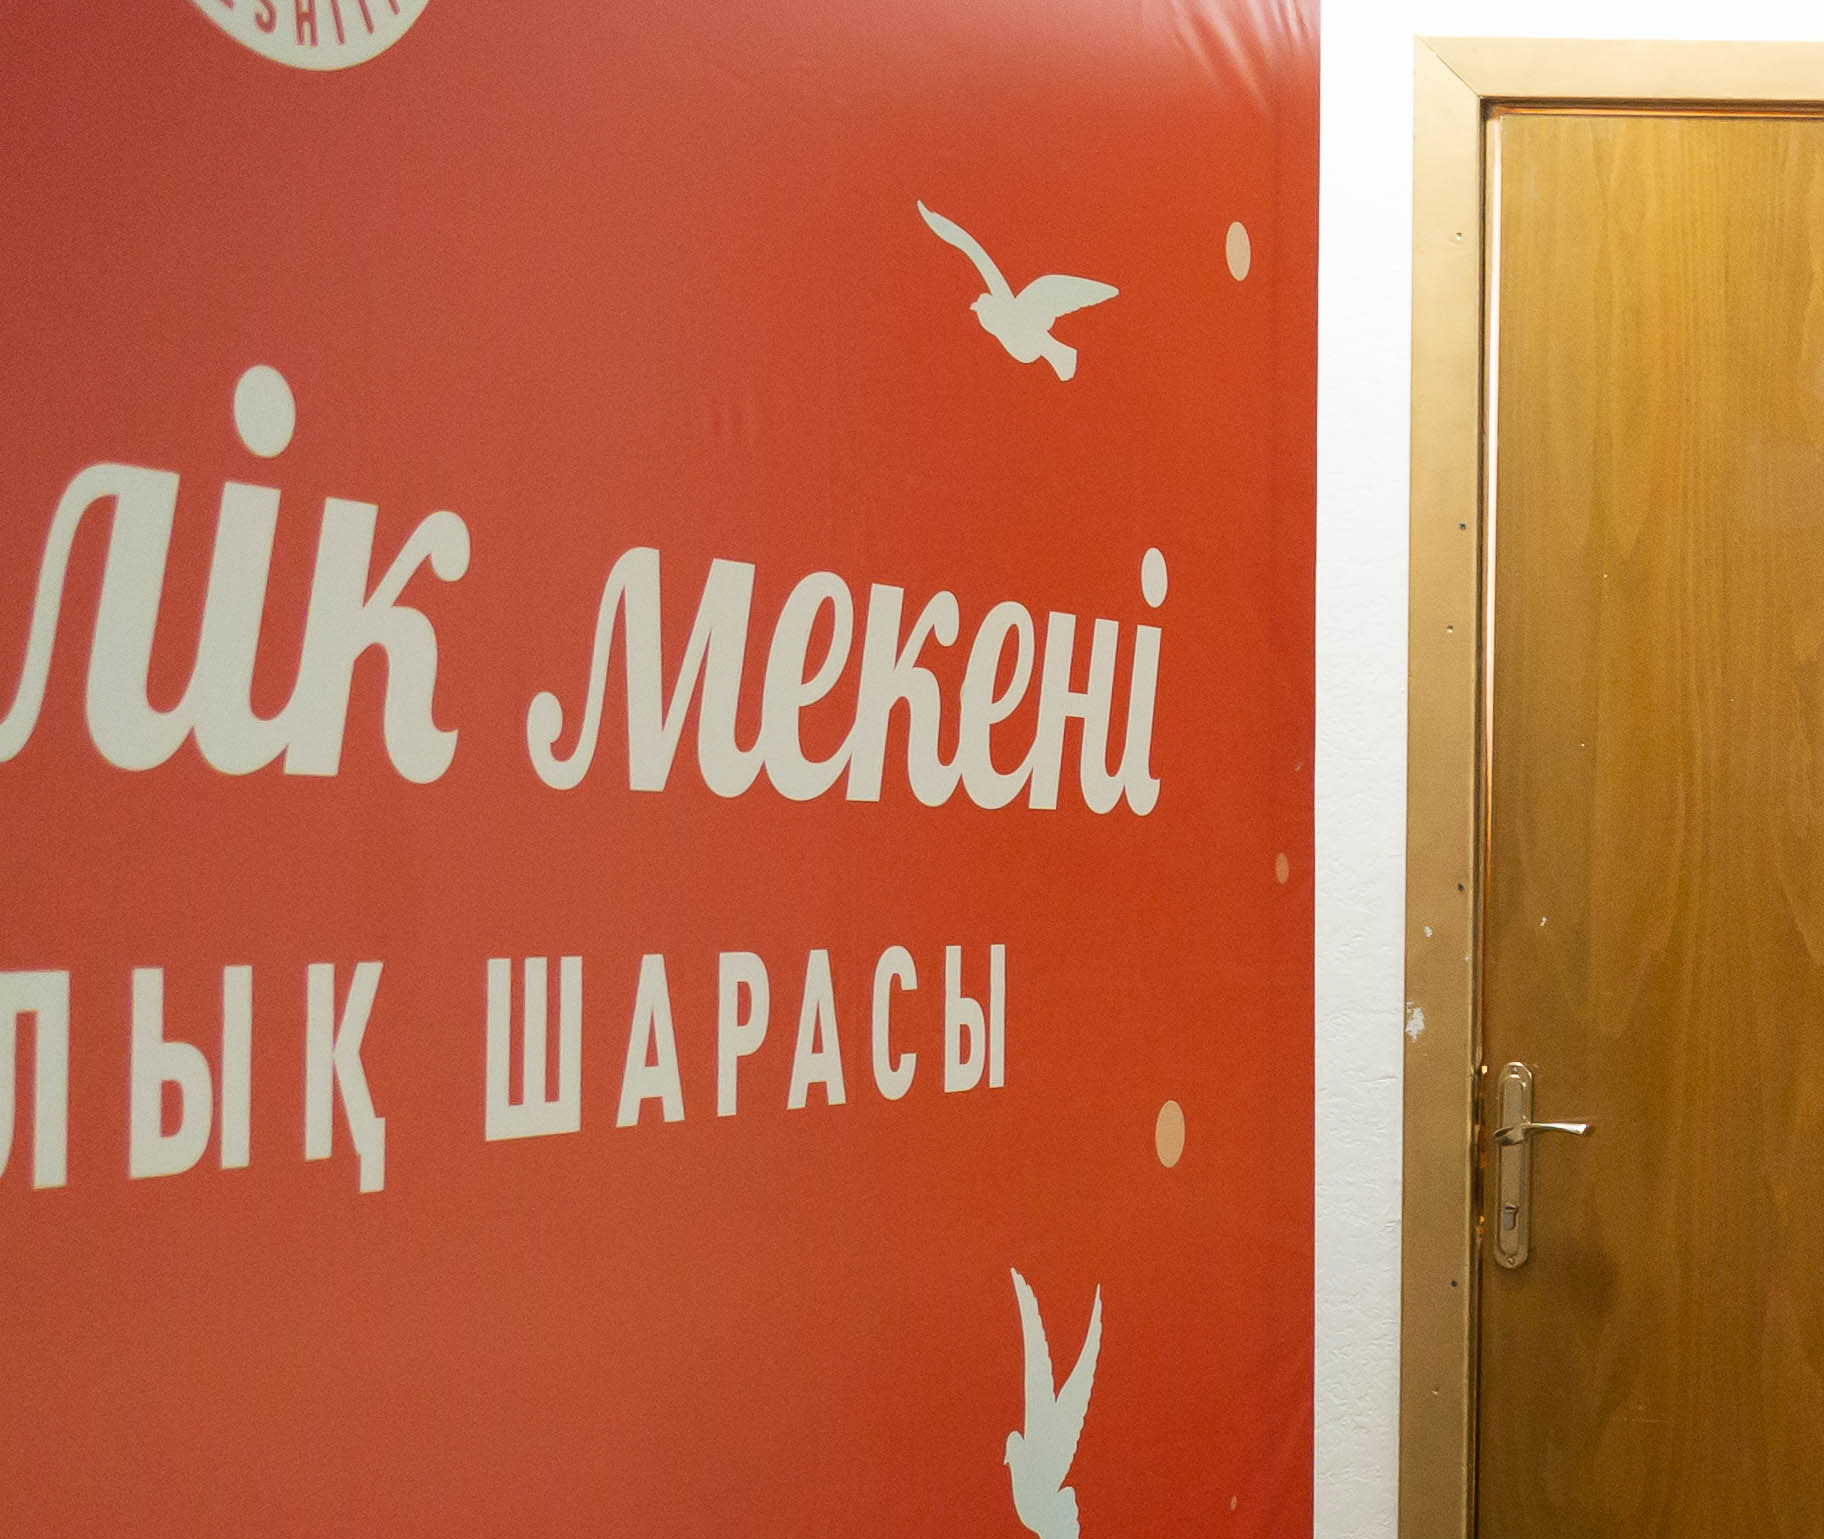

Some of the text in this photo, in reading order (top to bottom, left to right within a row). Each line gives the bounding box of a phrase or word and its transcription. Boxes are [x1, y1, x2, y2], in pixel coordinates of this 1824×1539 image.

[0, 364, 1167, 816] лік мекені
[0, 944, 1005, 1192] ЛЫҚ ШАРАСЫ
